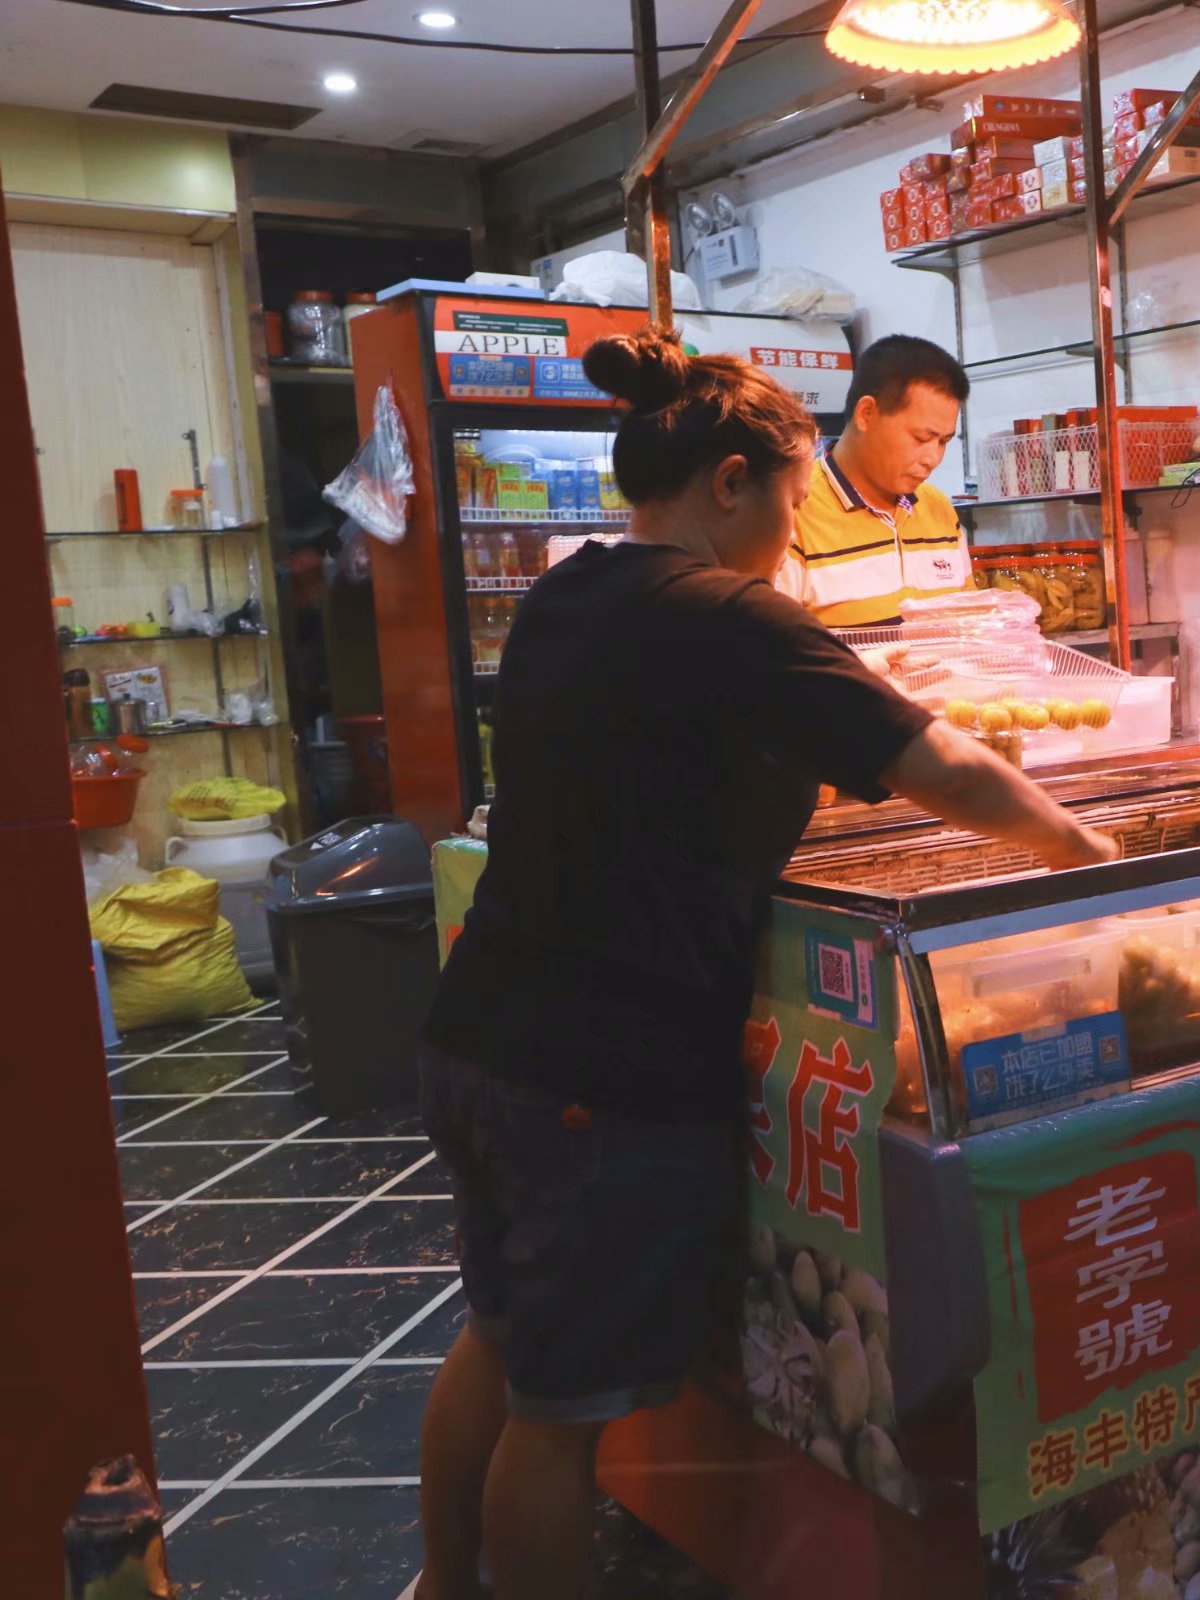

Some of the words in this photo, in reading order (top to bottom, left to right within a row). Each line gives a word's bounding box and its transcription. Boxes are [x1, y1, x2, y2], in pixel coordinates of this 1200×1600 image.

[457, 333, 561, 356] APPLE
[756, 349, 839, 369] 节能保鲜
[1001, 1031, 1094, 1074] 本店已加盟
[1004, 1056, 1096, 1101] 饿了么外卖
[1062, 1176, 1173, 1382] 老字號
